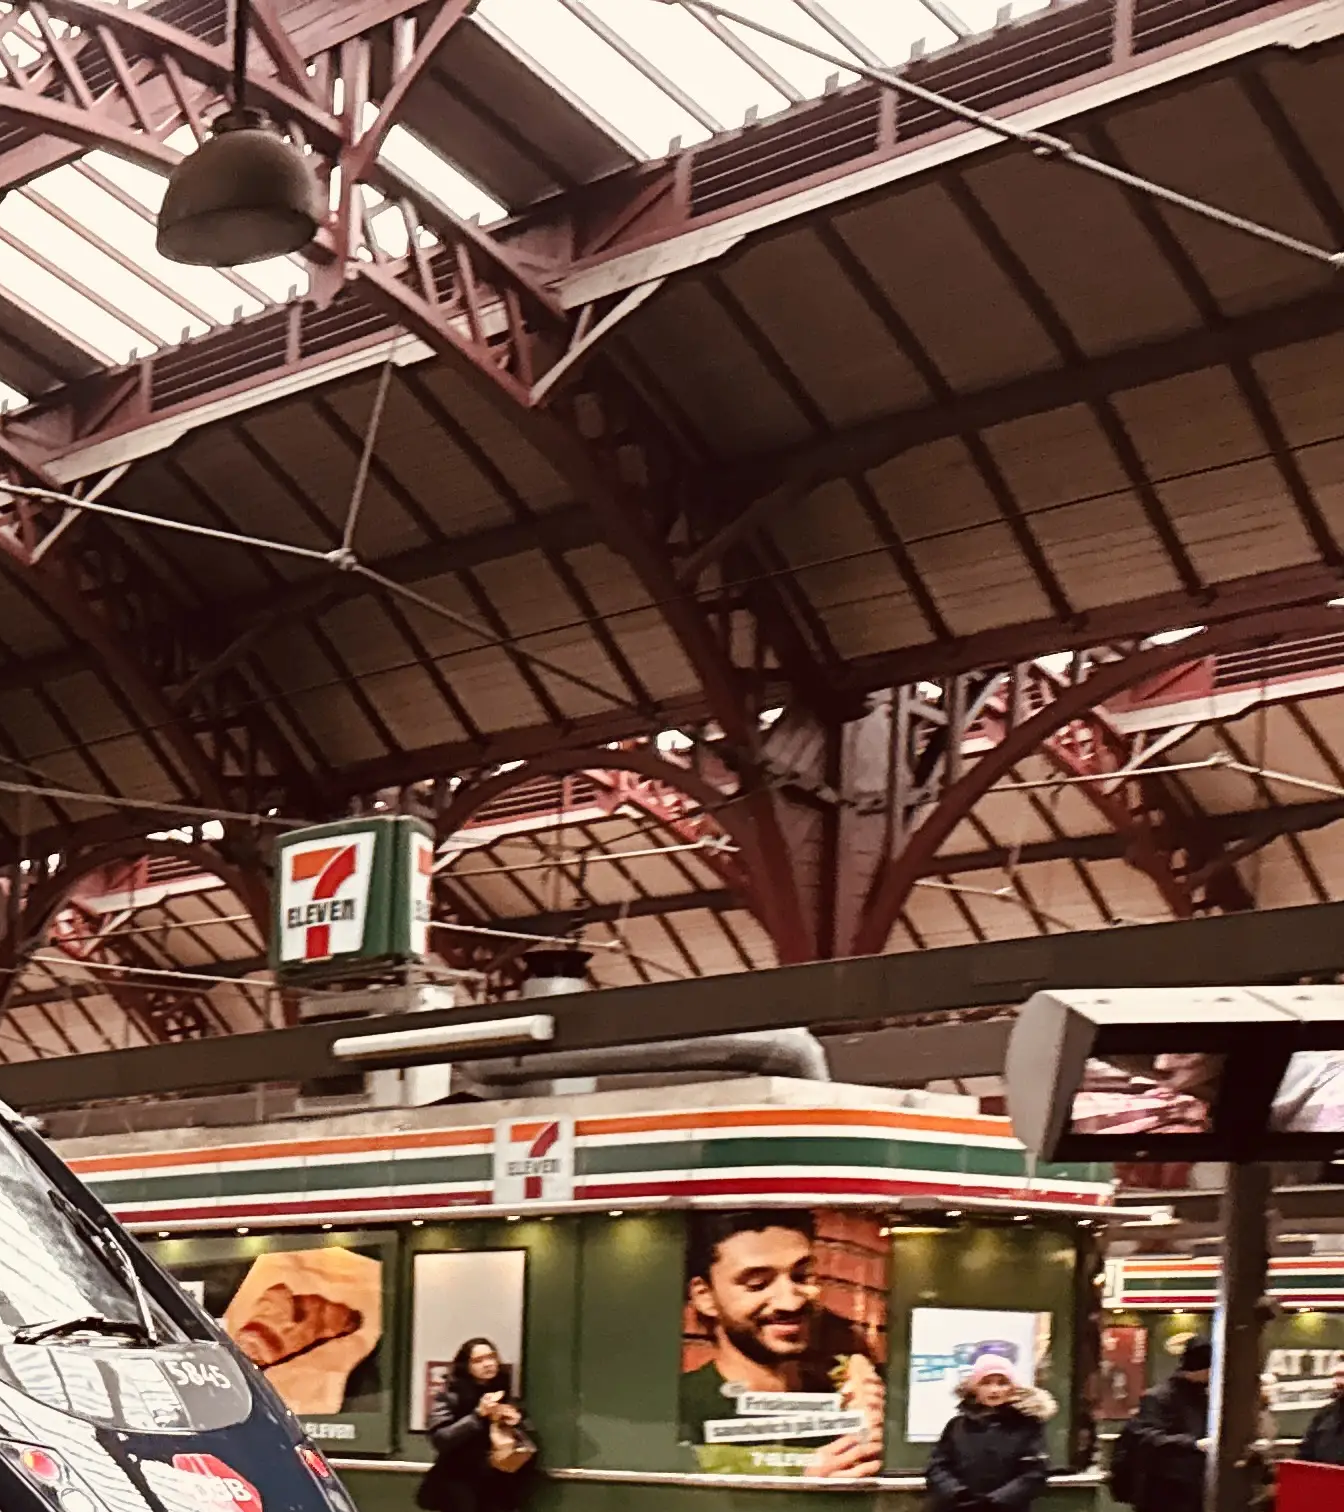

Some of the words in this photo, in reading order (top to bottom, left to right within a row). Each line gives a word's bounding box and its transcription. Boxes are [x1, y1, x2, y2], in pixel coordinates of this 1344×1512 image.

[291, 843, 357, 960] 7
[510, 1121, 560, 1199] 7
[165, 1361, 231, 1389] 5845
